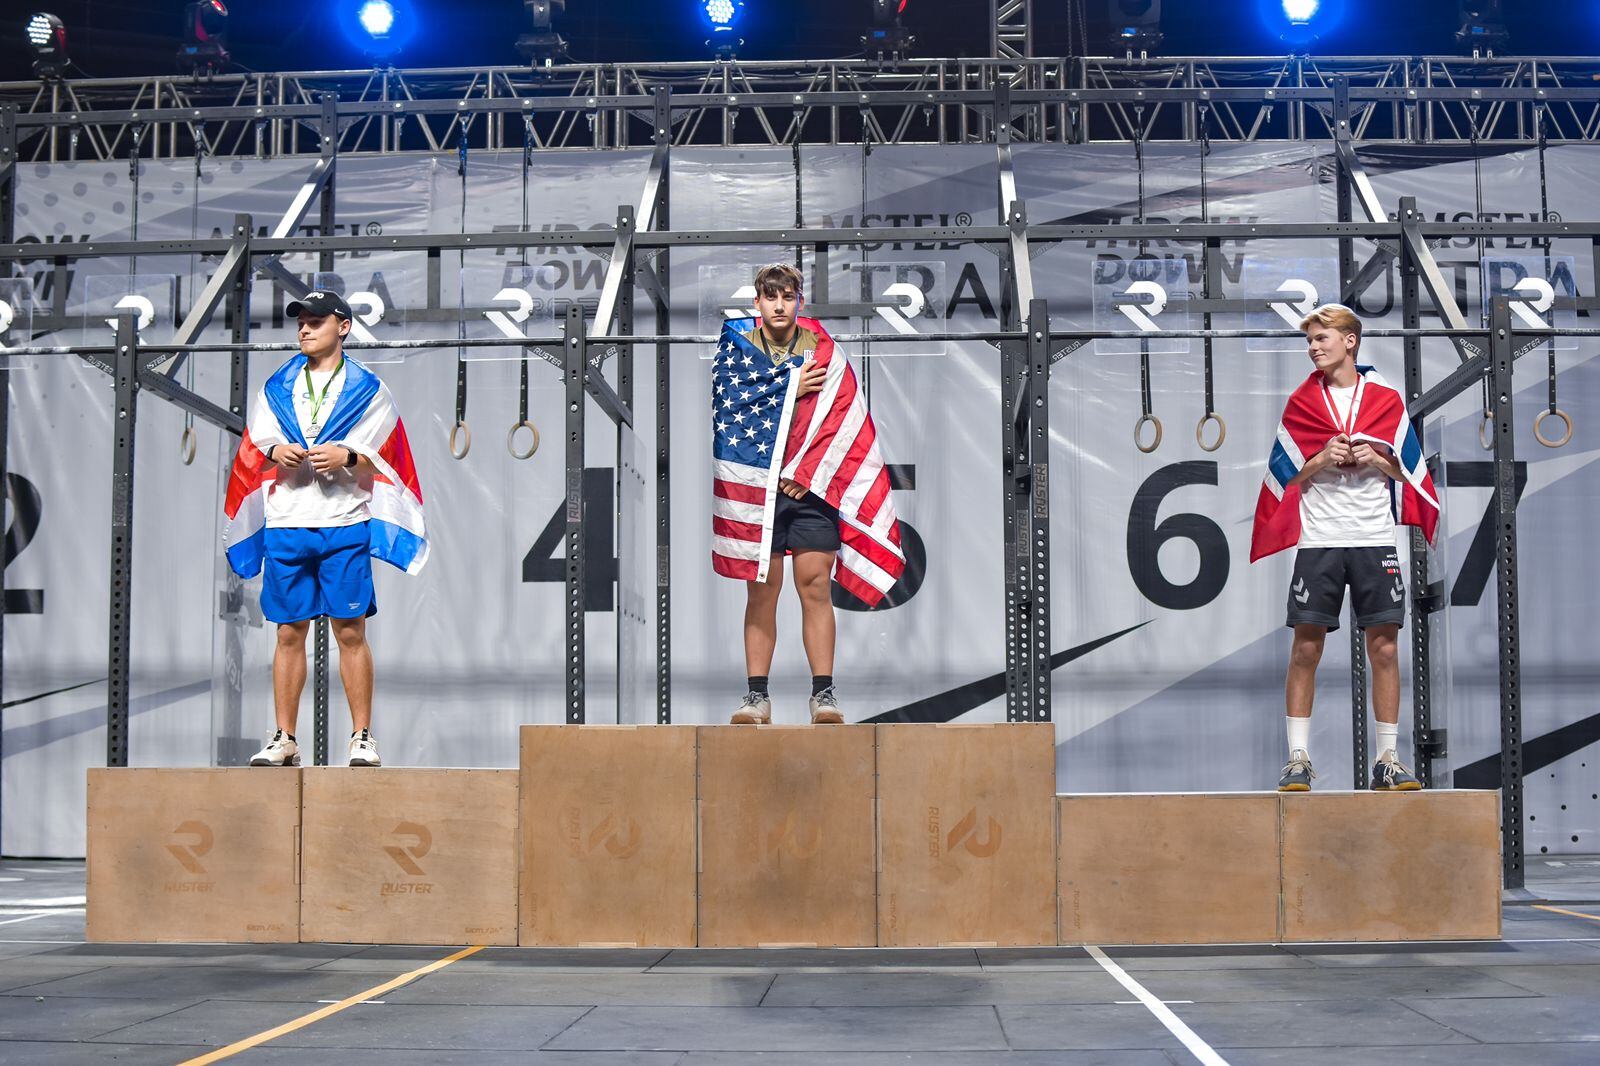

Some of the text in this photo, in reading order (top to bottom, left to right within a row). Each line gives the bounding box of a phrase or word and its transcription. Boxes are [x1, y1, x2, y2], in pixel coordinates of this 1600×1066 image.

[533, 346, 562, 367] RUSTER
[1513, 337, 1541, 358] RUSTER
[1036, 466, 1047, 516] RUSTER
[523, 467, 620, 611] 4
[1019, 512, 1028, 555] RUSTER
[1127, 460, 1230, 610] 6
[1446, 461, 1527, 606] 7
[929, 805, 941, 858] RUSTER
[380, 882, 434, 896] RUSTER
